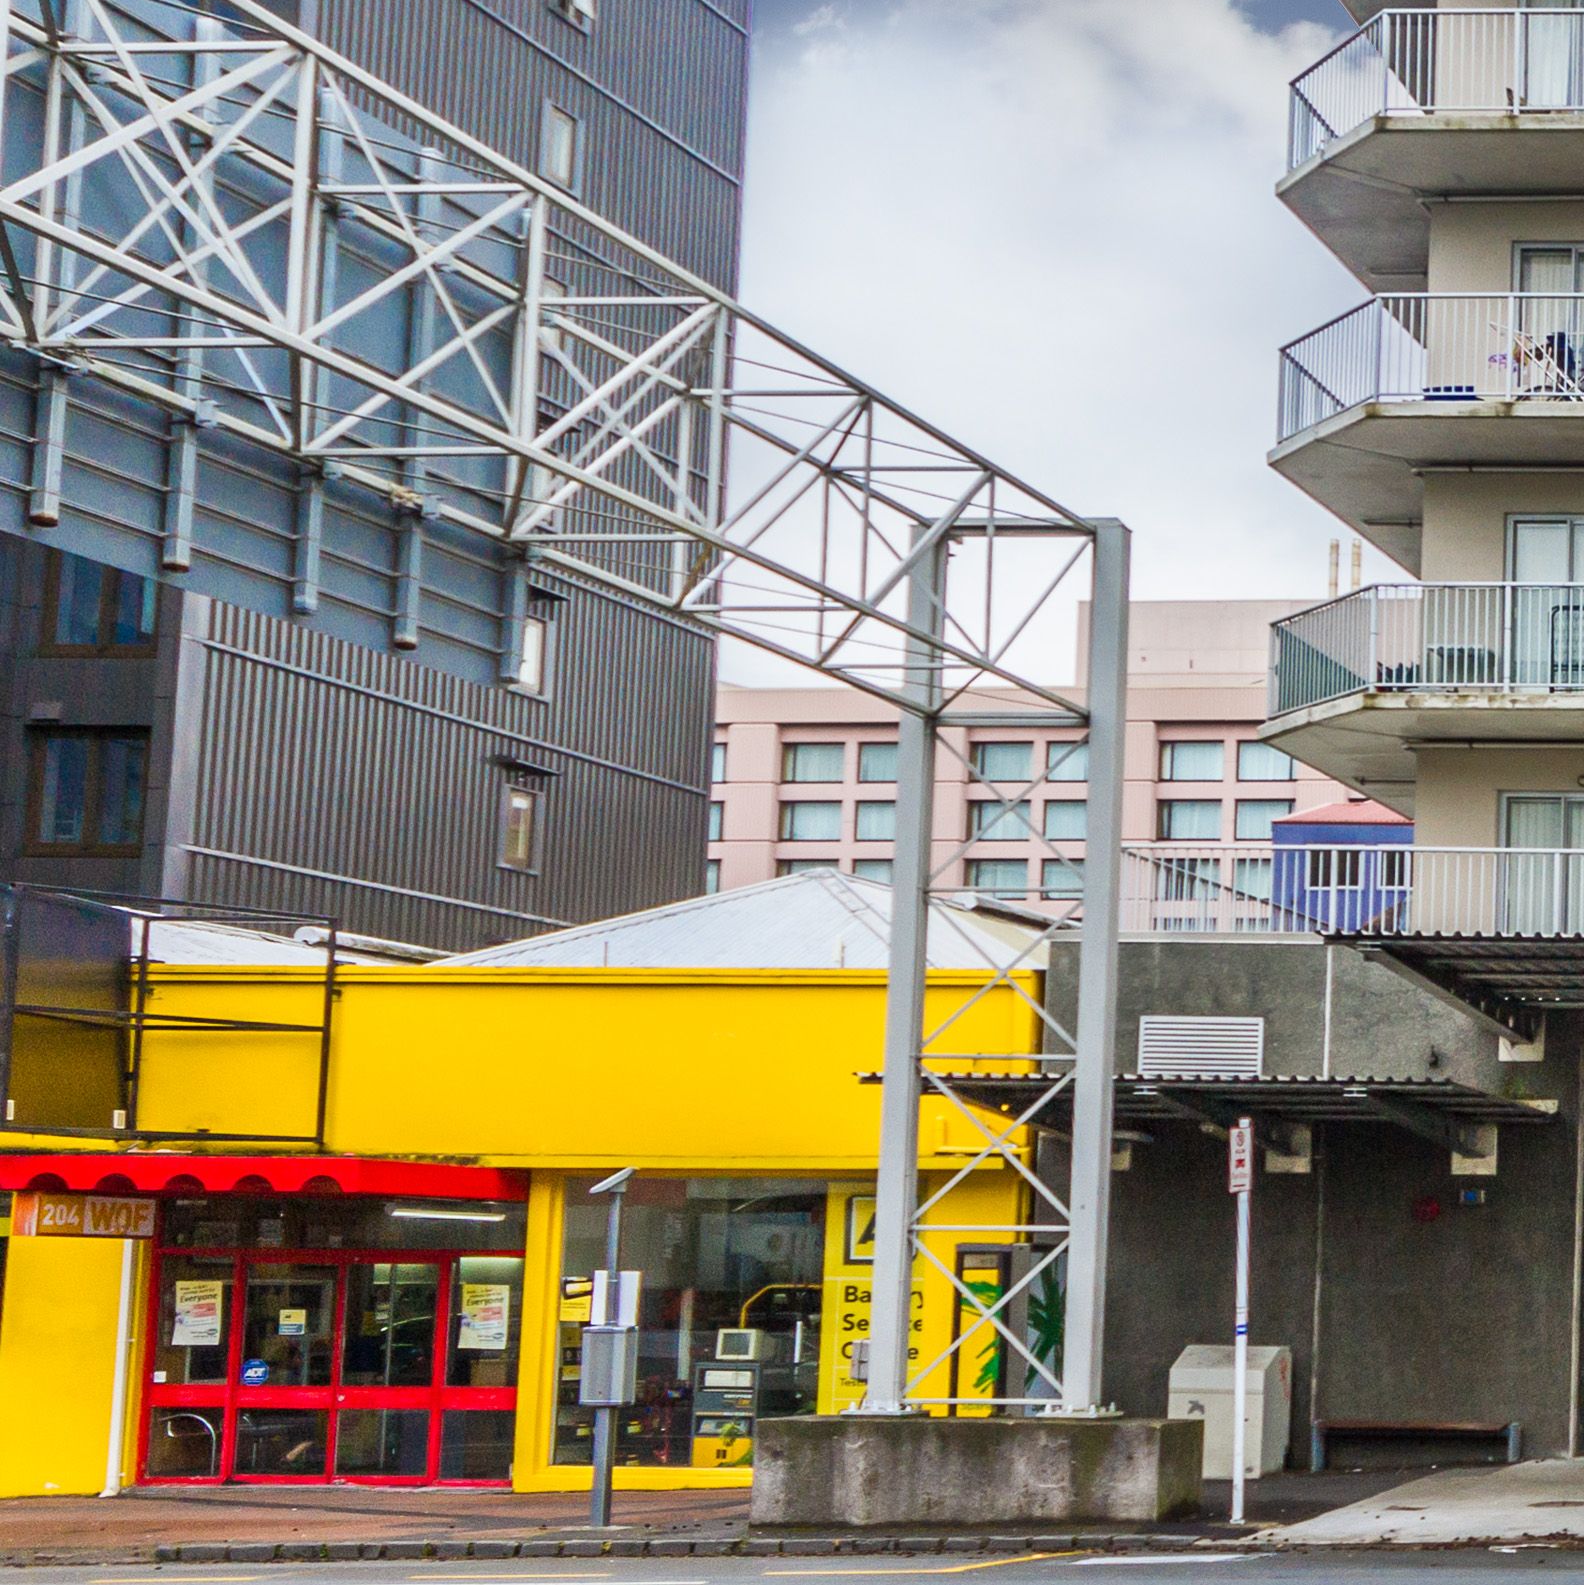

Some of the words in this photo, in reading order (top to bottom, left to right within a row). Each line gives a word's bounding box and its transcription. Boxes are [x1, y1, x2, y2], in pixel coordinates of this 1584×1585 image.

[41, 1203, 80, 1227] 204
[89, 1200, 151, 1233] WOF
[179, 1292, 218, 1304] Everyone
